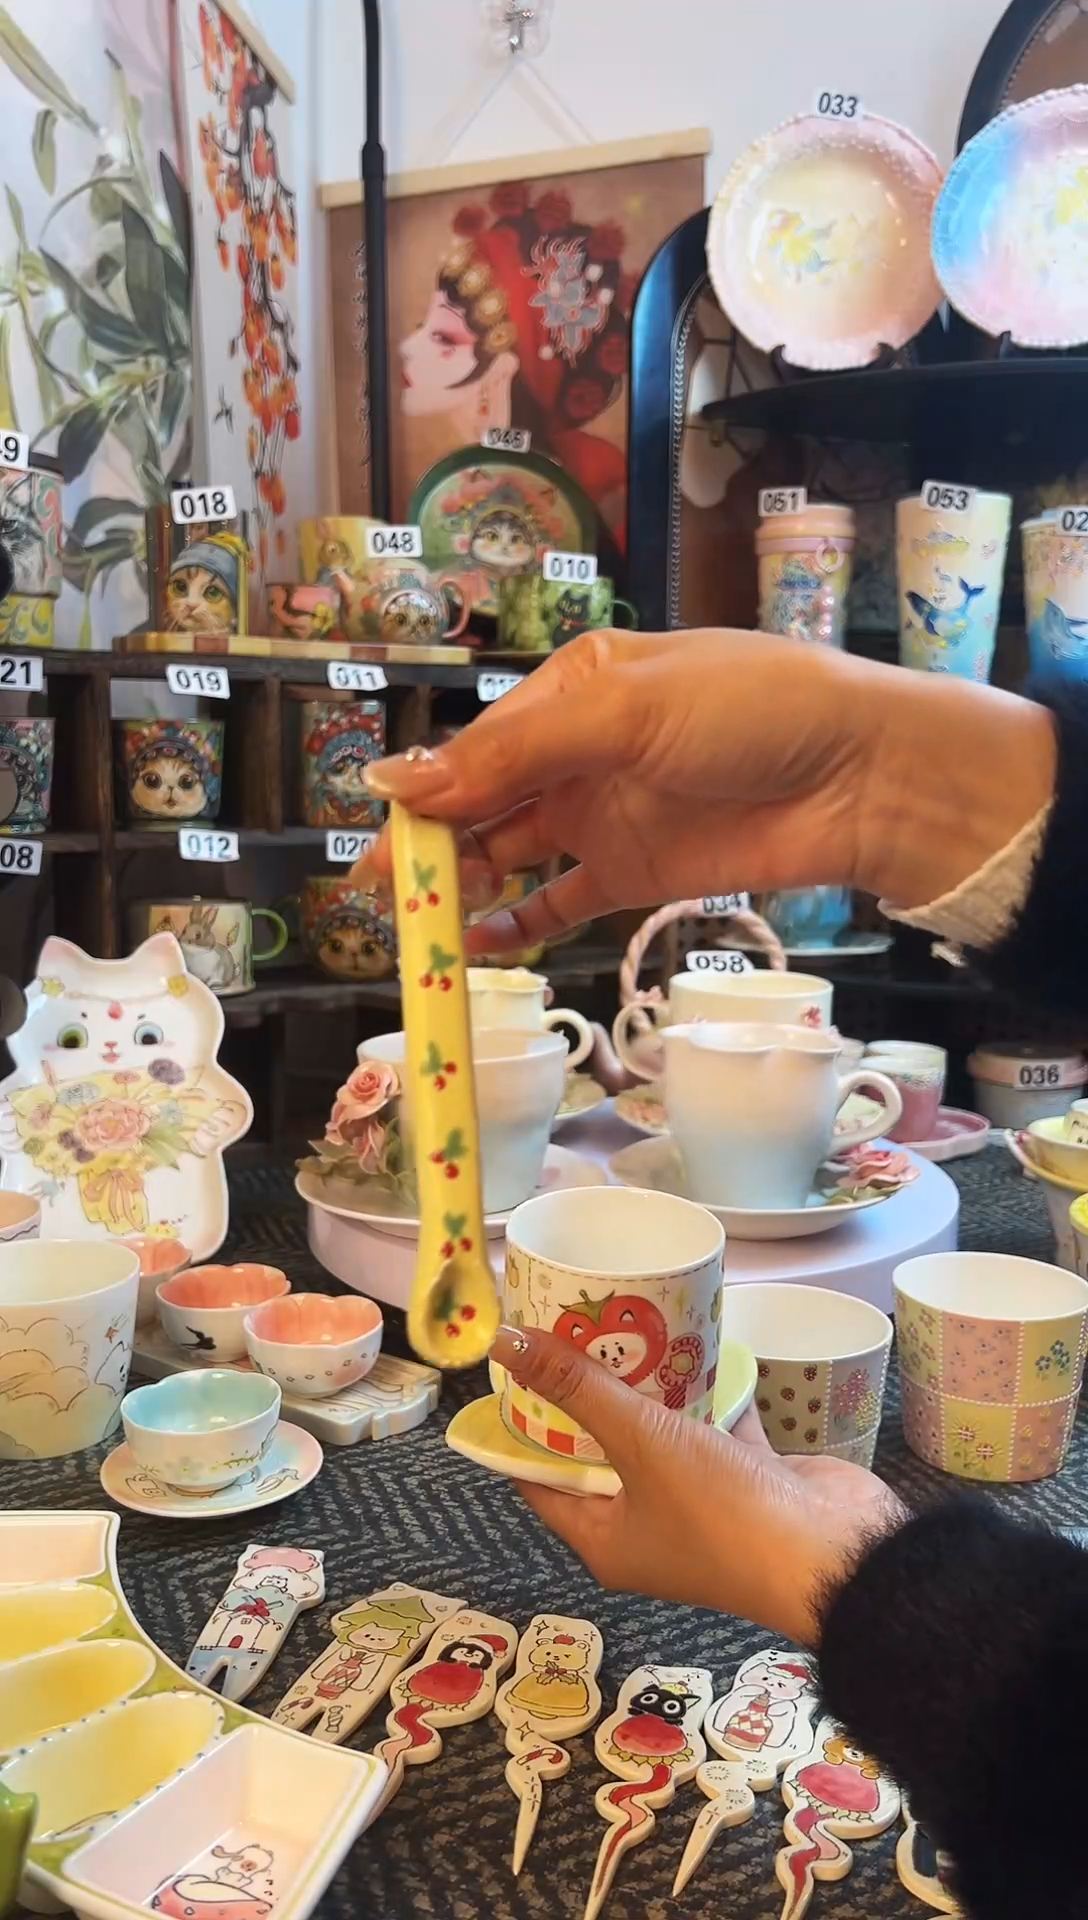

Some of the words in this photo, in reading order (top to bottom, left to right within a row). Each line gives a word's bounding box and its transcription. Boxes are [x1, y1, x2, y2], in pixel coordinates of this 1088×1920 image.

[819, 92, 858, 118] 033
[0, 436, 19, 462] 9
[180, 491, 227, 518] 018
[927, 486, 969, 511] 053
[373, 532, 413, 554] 048
[551, 557, 588, 580] 010
[0, 659, 31, 686] 21
[176, 669, 221, 691] 019
[336, 667, 377, 688] 011
[0, 843, 34, 869] 08
[188, 833, 232, 860] 012
[696, 955, 744, 974] 058
[1019, 1064, 1060, 1085] 036
